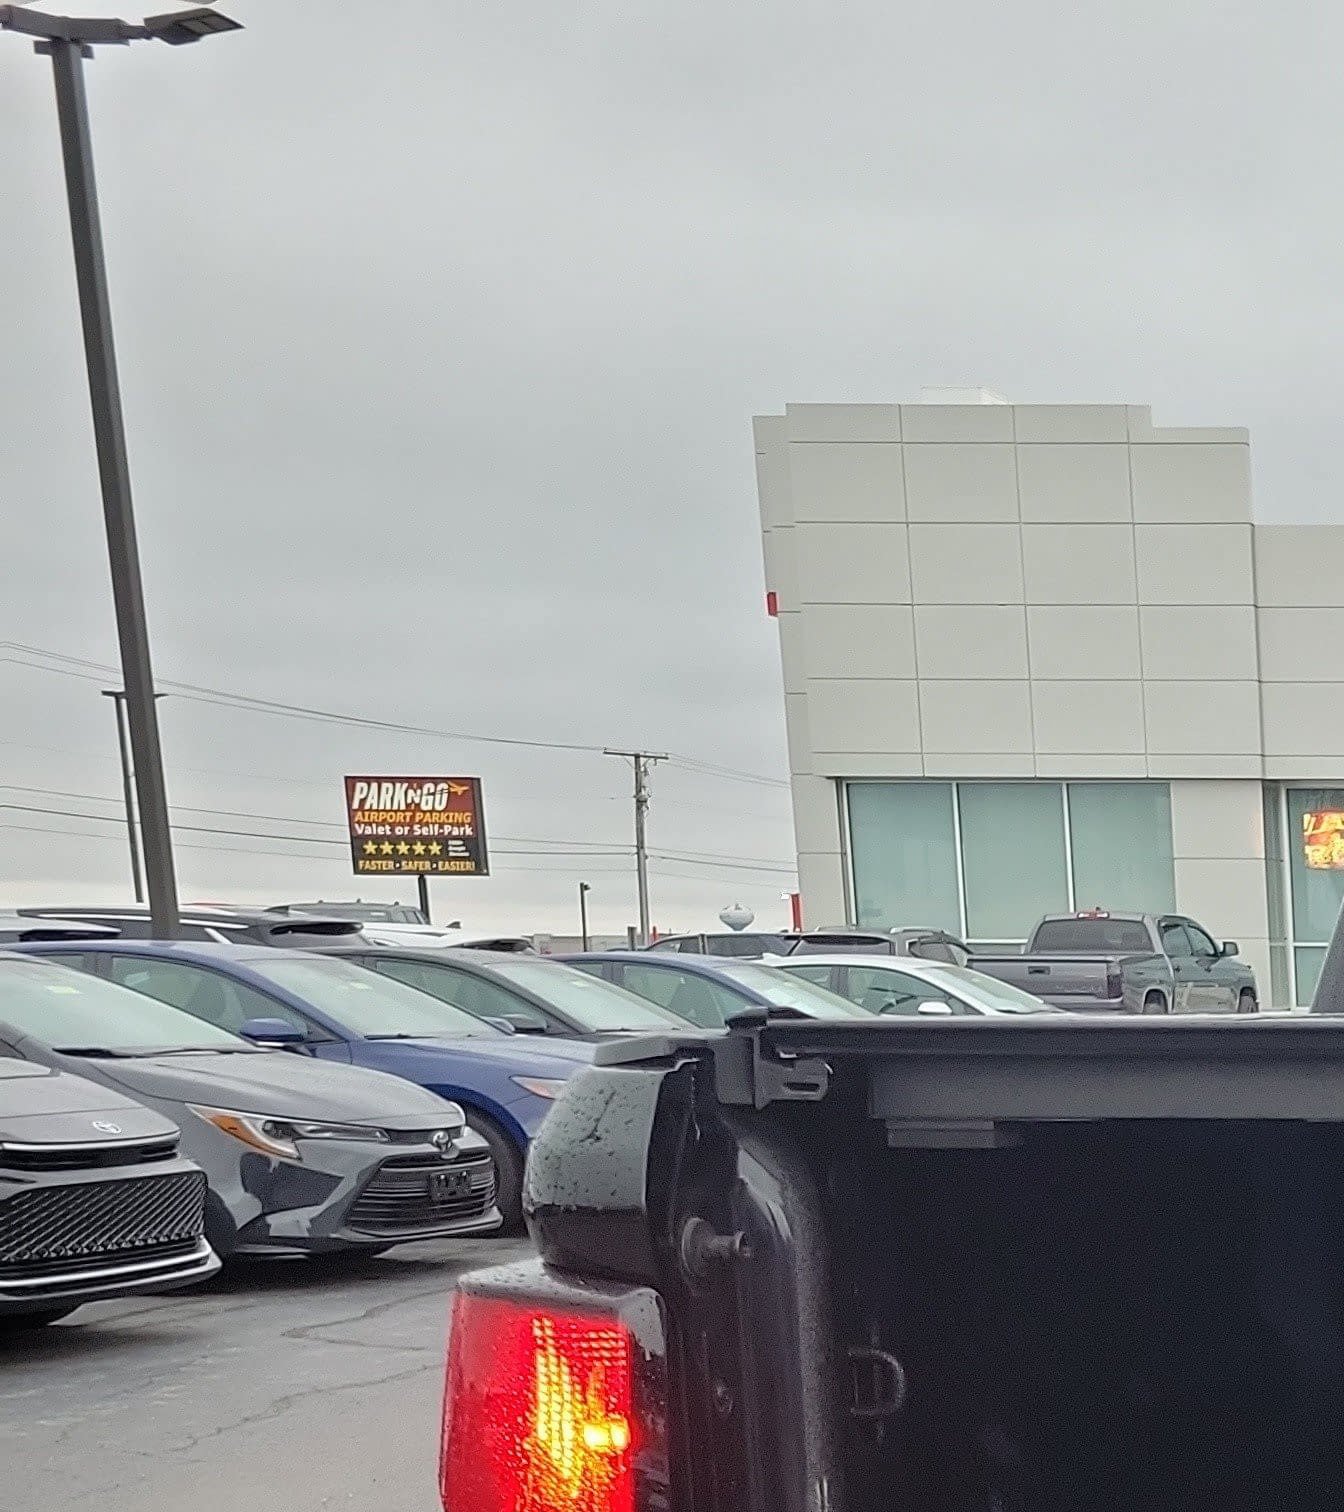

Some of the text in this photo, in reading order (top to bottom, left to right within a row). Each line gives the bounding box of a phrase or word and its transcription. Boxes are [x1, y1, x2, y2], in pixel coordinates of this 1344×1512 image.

[355, 811, 473, 823] AIRPORT PARKING
[355, 823, 473, 836] Valet or Self-Park
[358, 860, 394, 871] FASTER
[400, 860, 431, 871] SAFER
